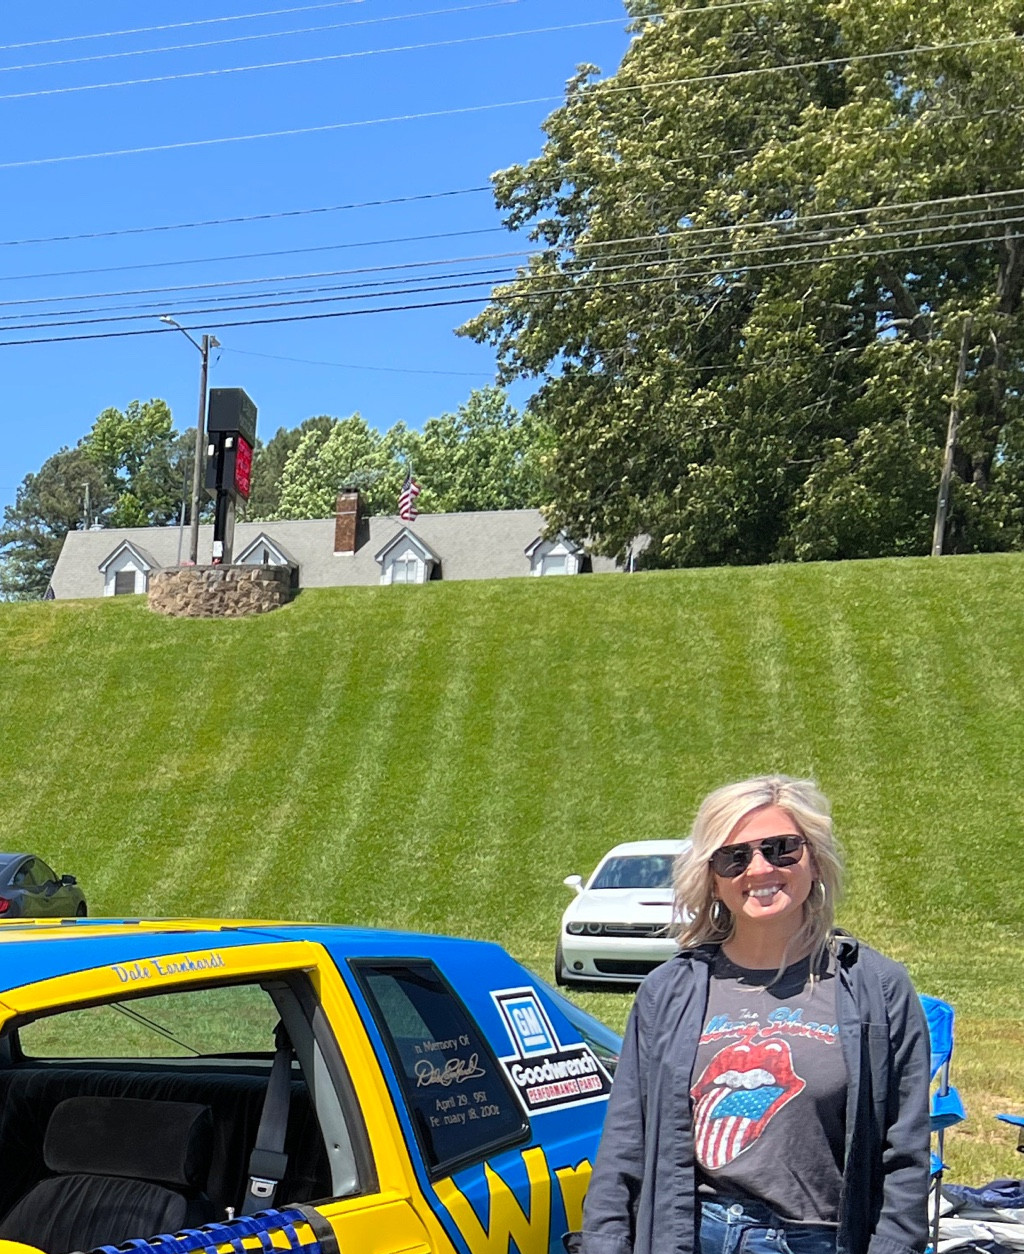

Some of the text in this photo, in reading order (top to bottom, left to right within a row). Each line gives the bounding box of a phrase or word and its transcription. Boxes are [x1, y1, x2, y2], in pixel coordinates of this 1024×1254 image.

[112, 952, 225, 982] Dale Earnhardt
[512, 1007, 543, 1036] GM
[511, 1051, 597, 1086] Goodwrench
[528, 1076, 602, 1102] PERFORMANCE PARTS
[436, 1096, 455, 1113] April
[430, 1113, 466, 1127] Feruary
